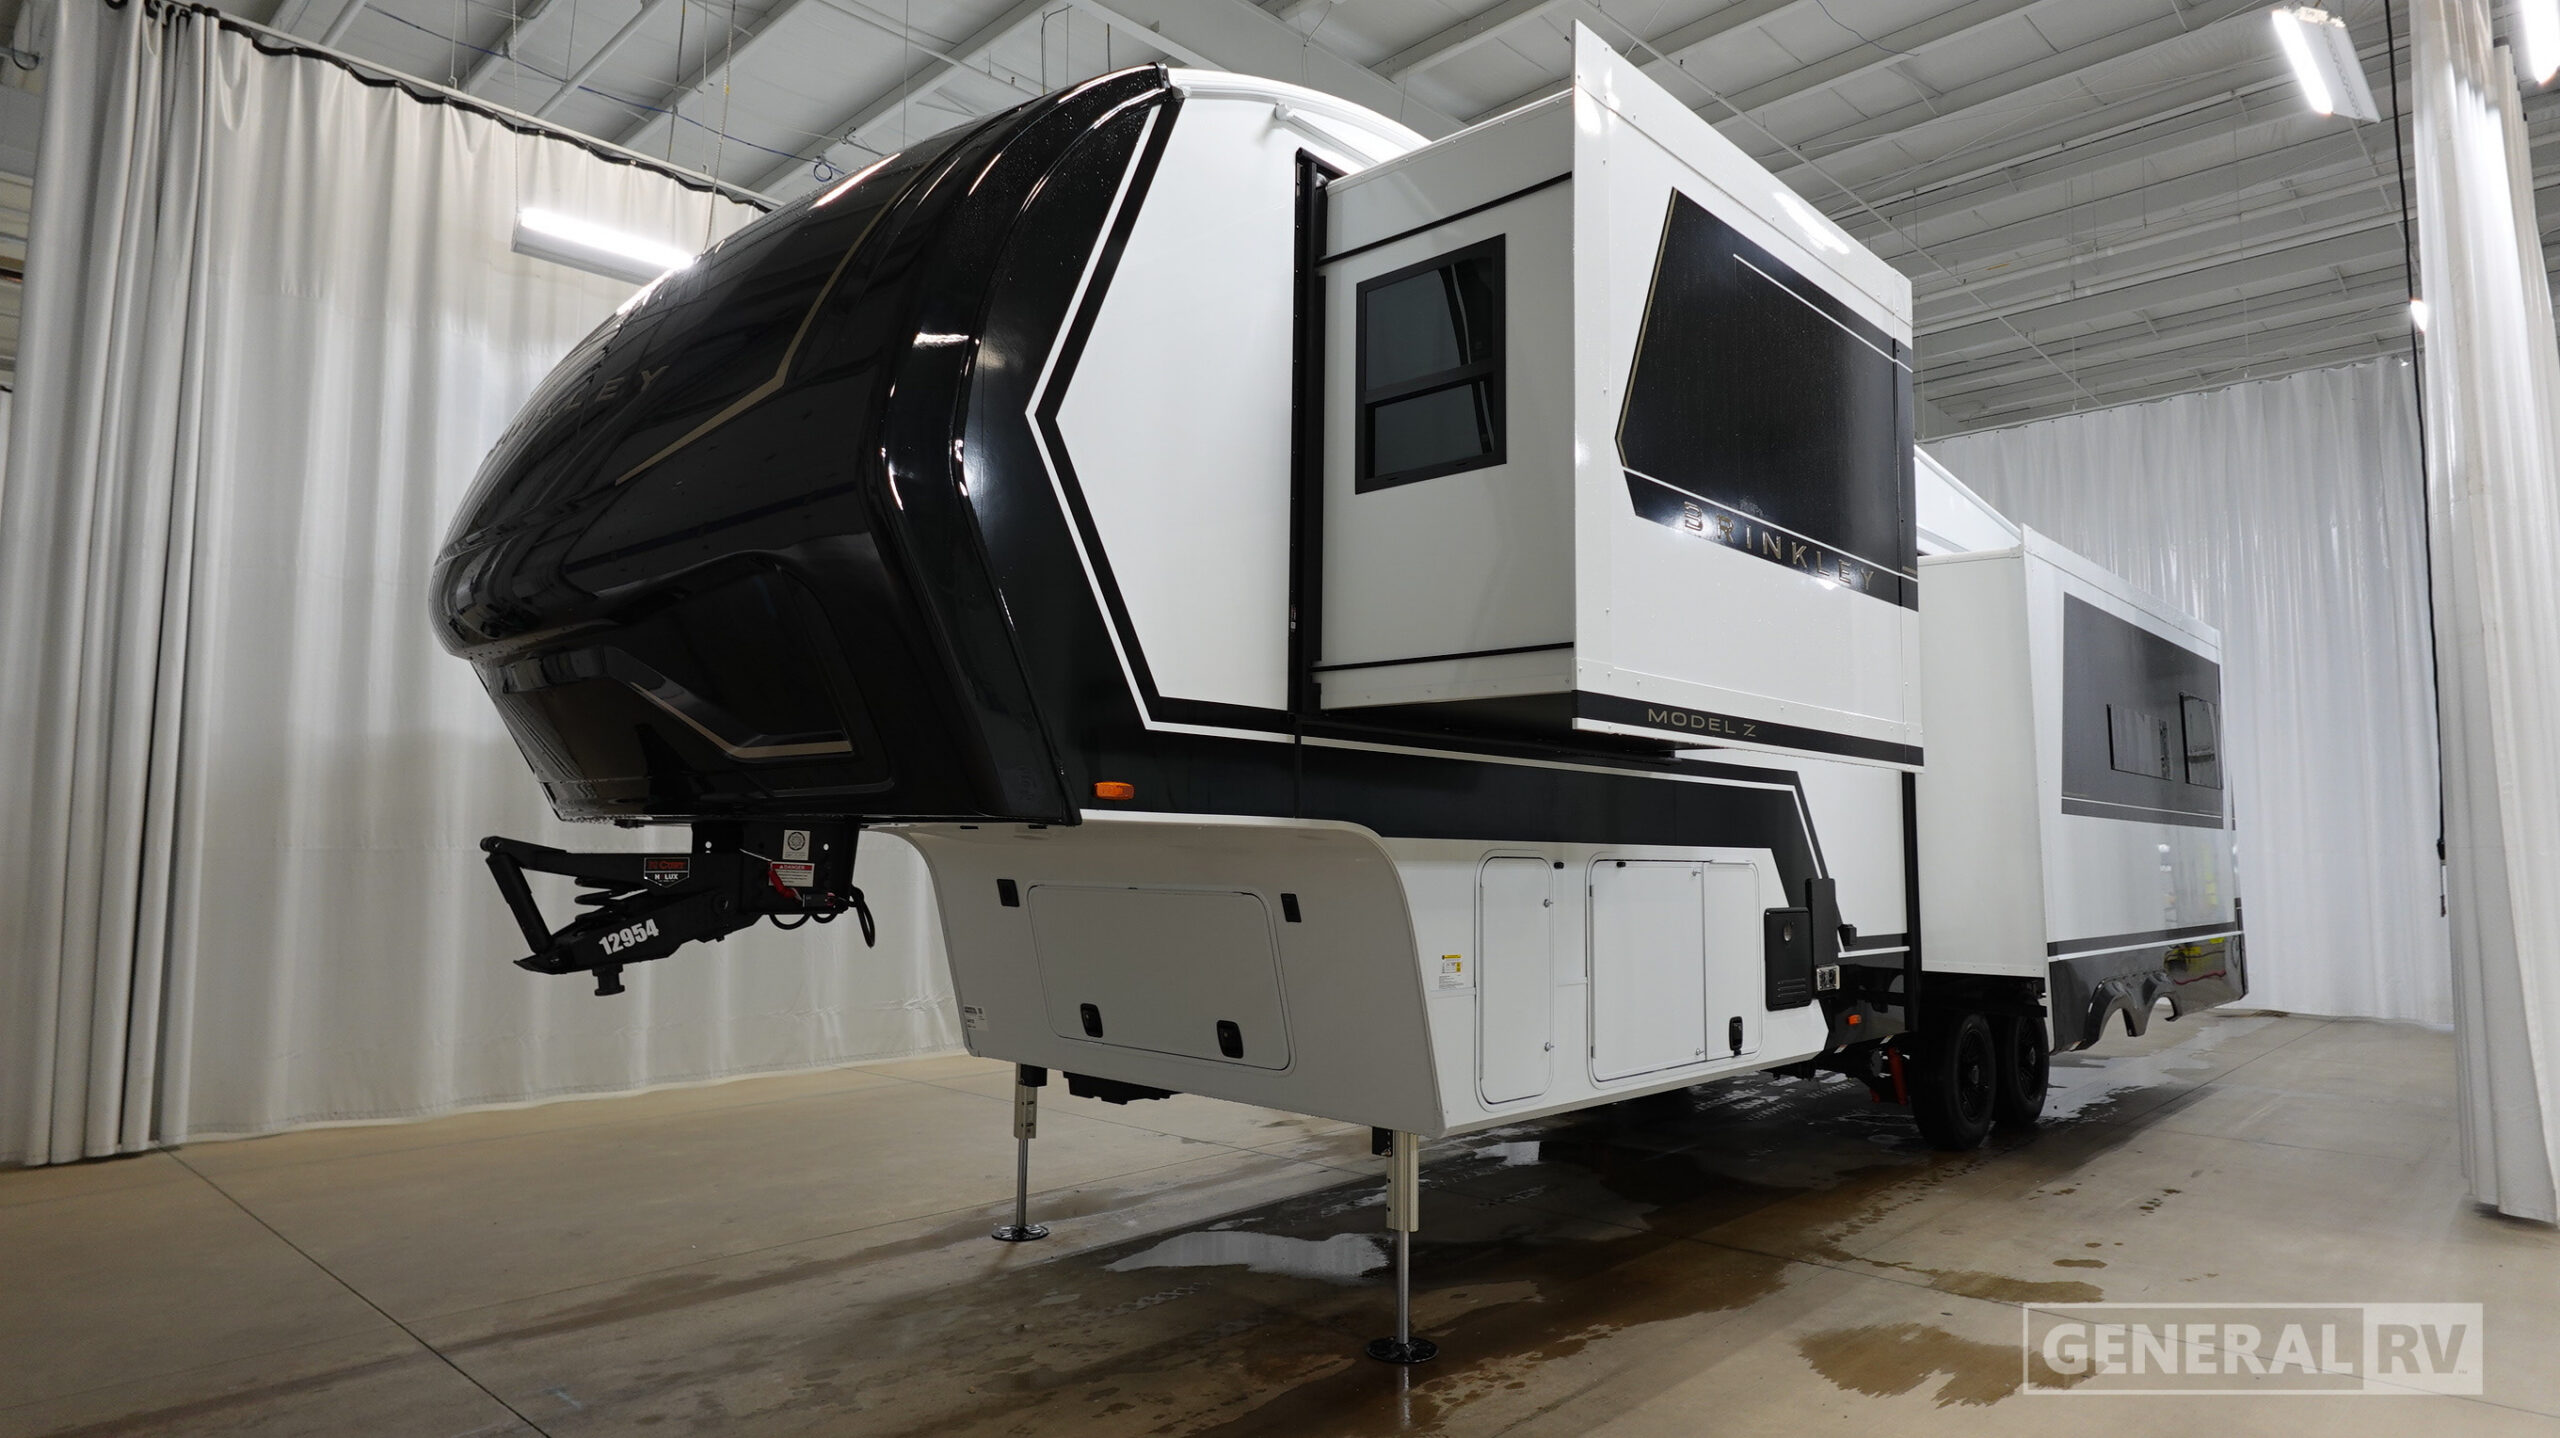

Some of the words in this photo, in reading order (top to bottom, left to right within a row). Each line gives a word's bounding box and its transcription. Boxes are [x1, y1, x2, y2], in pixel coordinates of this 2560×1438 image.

[1684, 501, 1874, 590] BRINKLEY
[1648, 708, 1736, 734] MODEL
[1743, 723, 1757, 737] Z
[598, 918, 660, 955] 12954
